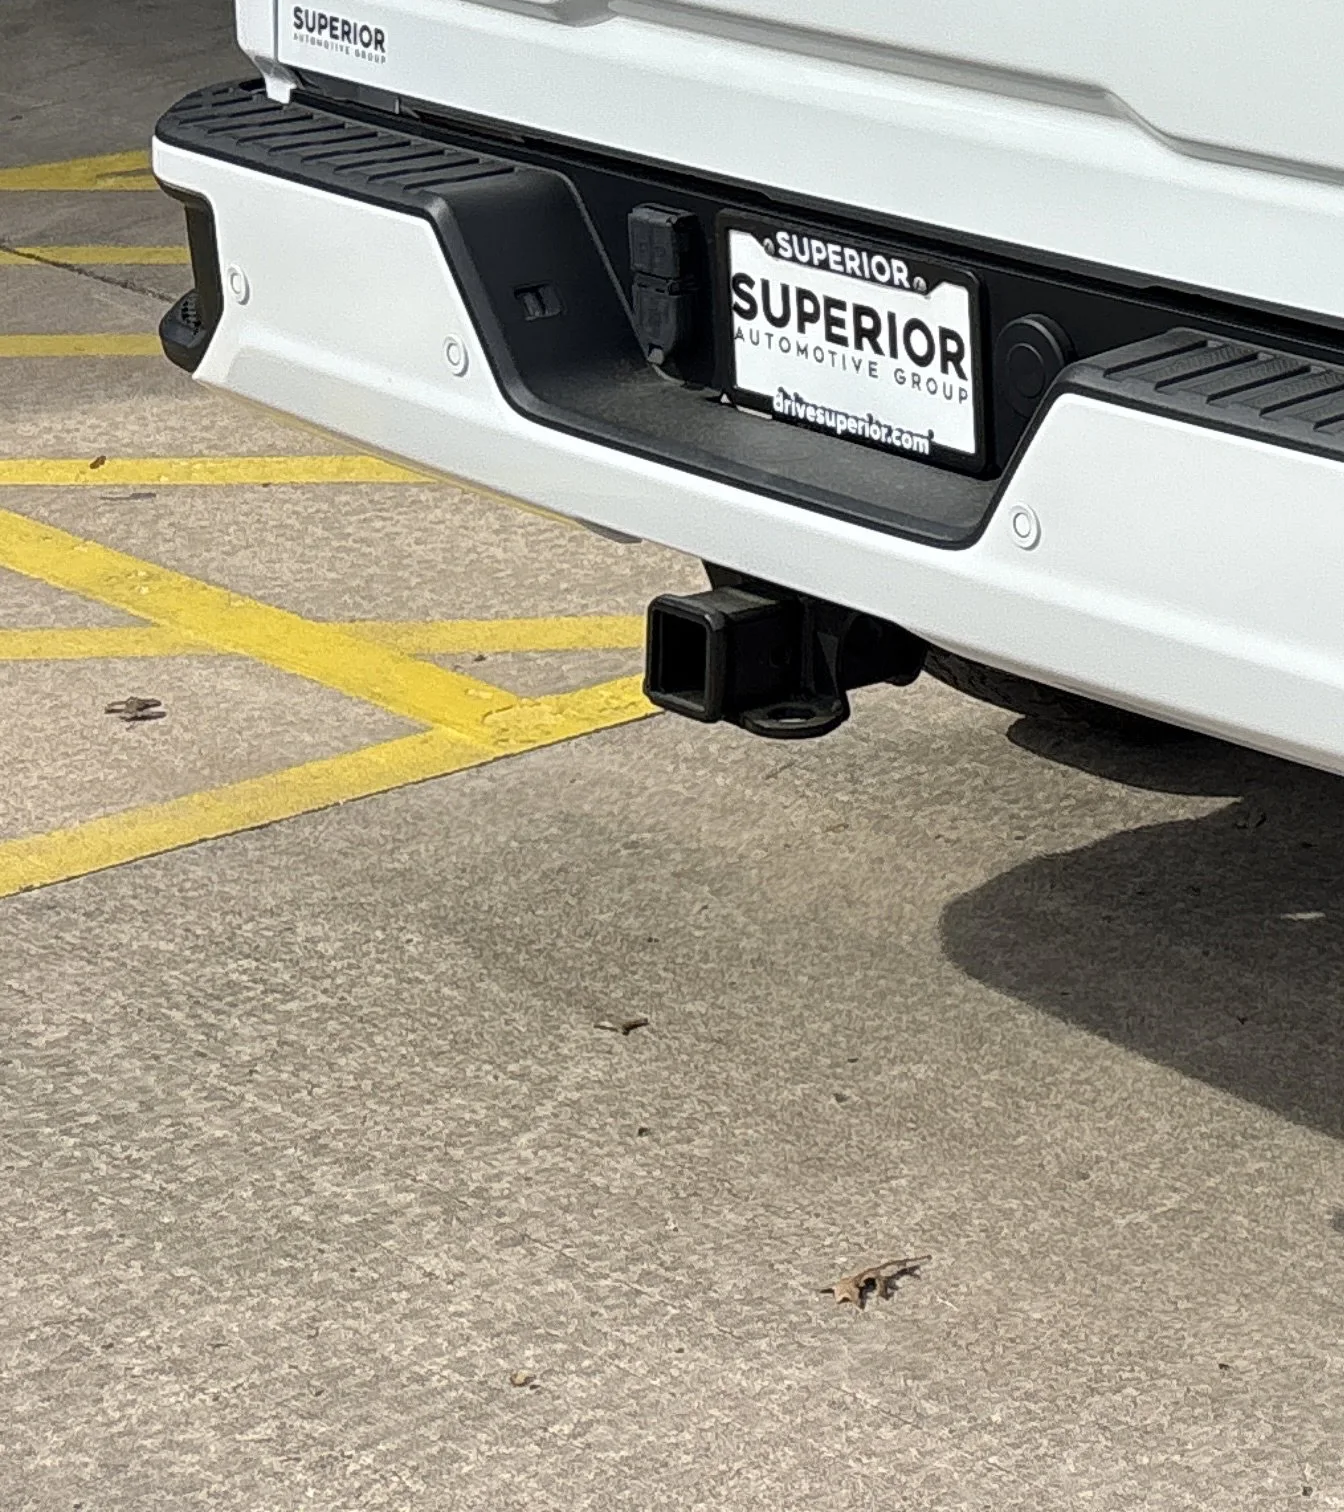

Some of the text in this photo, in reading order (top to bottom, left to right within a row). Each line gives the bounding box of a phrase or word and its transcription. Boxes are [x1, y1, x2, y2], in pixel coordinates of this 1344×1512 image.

[293, 6, 387, 54] SUPERIOR
[293, 33, 387, 64] AUTOMOTIVE GROUP
[775, 231, 911, 290] SUPERIOR
[731, 272, 968, 382] SUPERIOR
[734, 325, 968, 404] AUTOMOTIVE GROUP
[772, 388, 931, 455] drivesuperior.com
